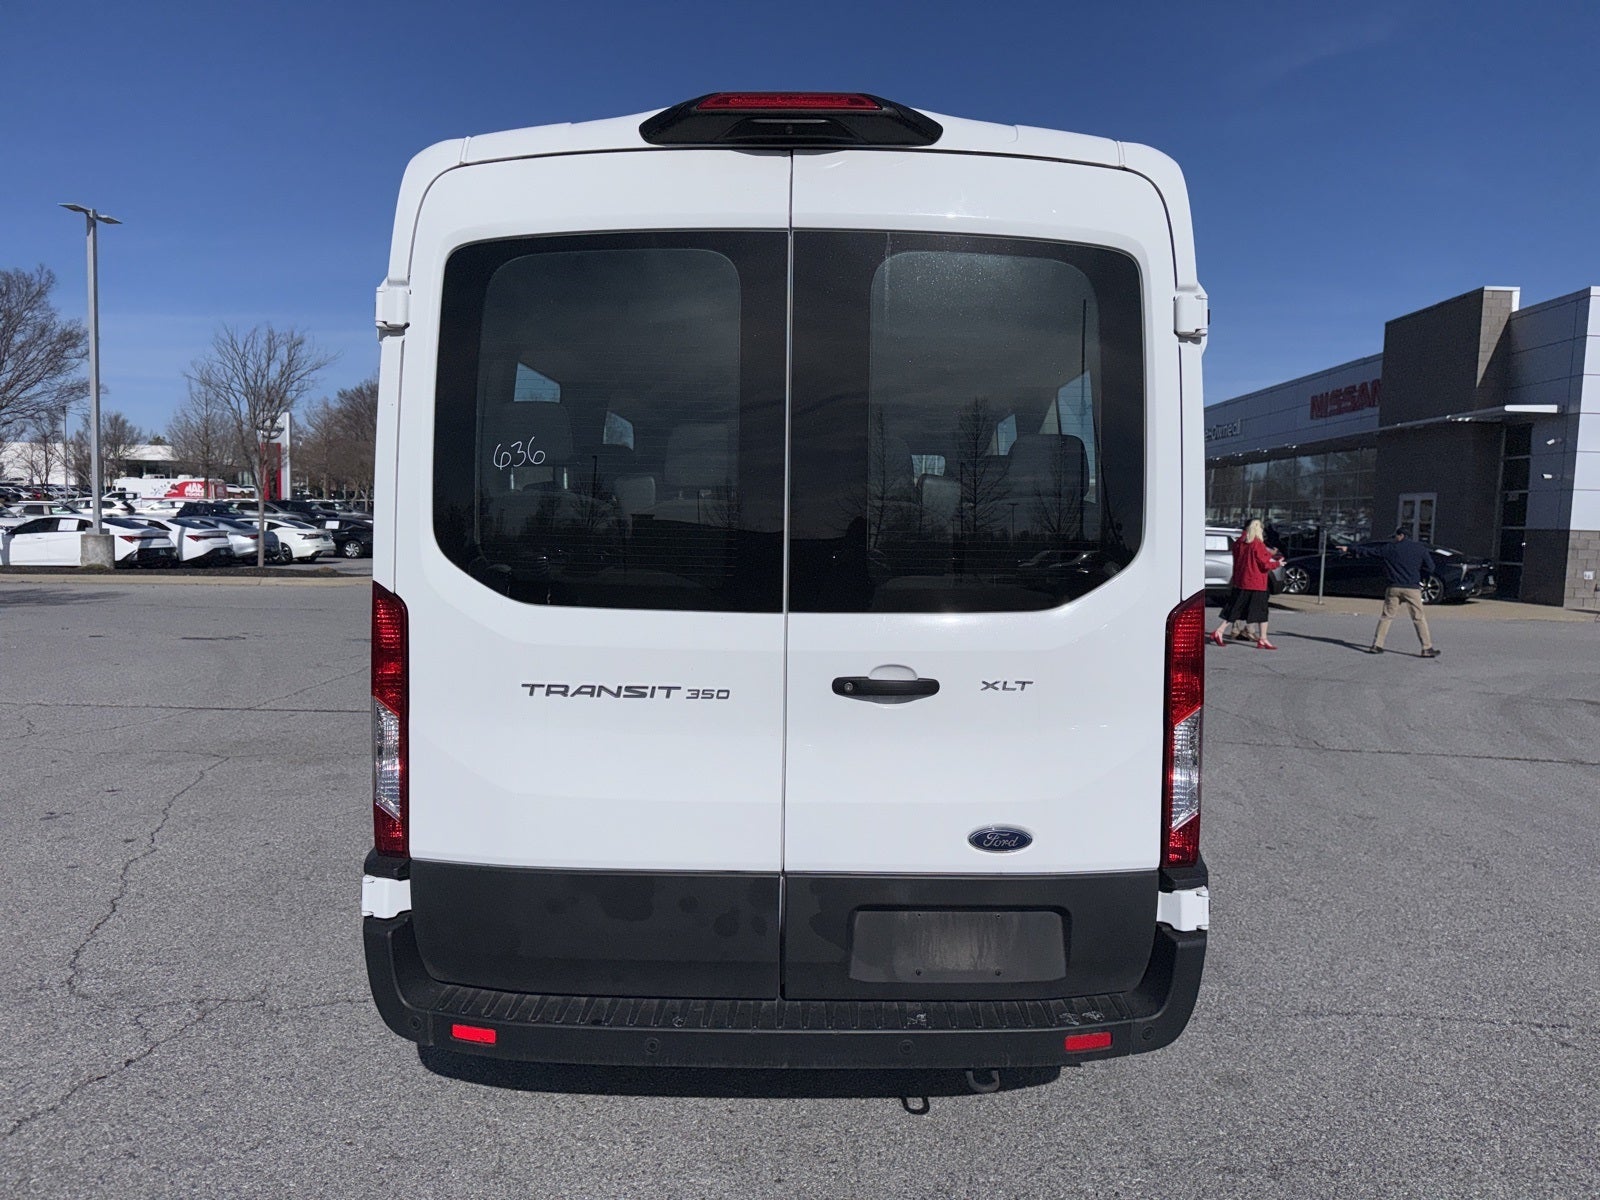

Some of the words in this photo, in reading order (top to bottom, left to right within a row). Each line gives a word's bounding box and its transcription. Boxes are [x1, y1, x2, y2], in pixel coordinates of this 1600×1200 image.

[493, 436, 546, 470] 636
[521, 683, 682, 699] TRANSIT
[686, 689, 730, 699] 350
[980, 680, 1034, 691] XLT
[982, 832, 1020, 847] Ford
